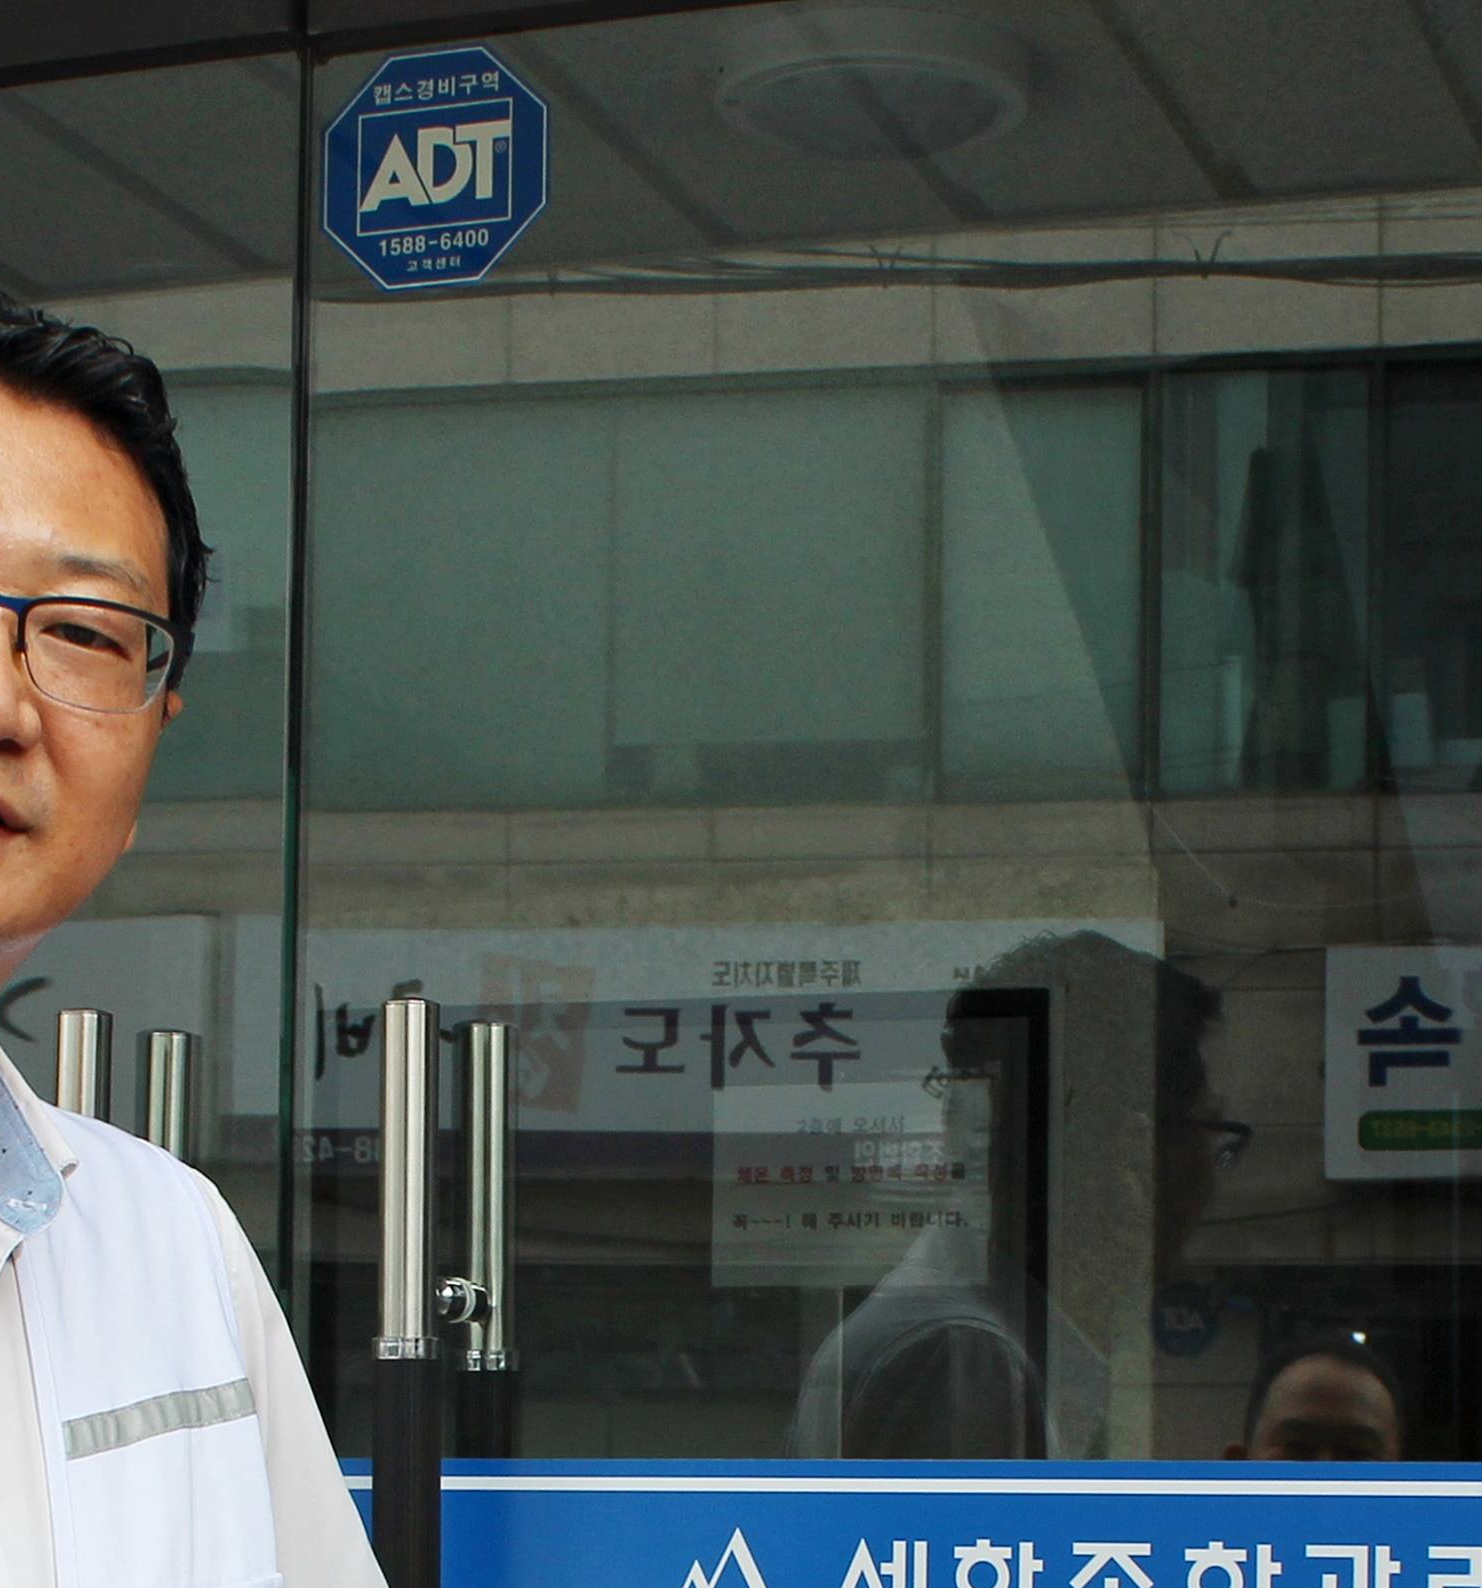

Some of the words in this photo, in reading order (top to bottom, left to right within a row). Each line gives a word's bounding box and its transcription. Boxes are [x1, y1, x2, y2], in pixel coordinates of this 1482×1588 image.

[373, 70, 501, 105] 캡스경비구역
[359, 119, 512, 213] ADT
[378, 228, 490, 258] 1588-6400
[405, 256, 462, 272] 고객센터
